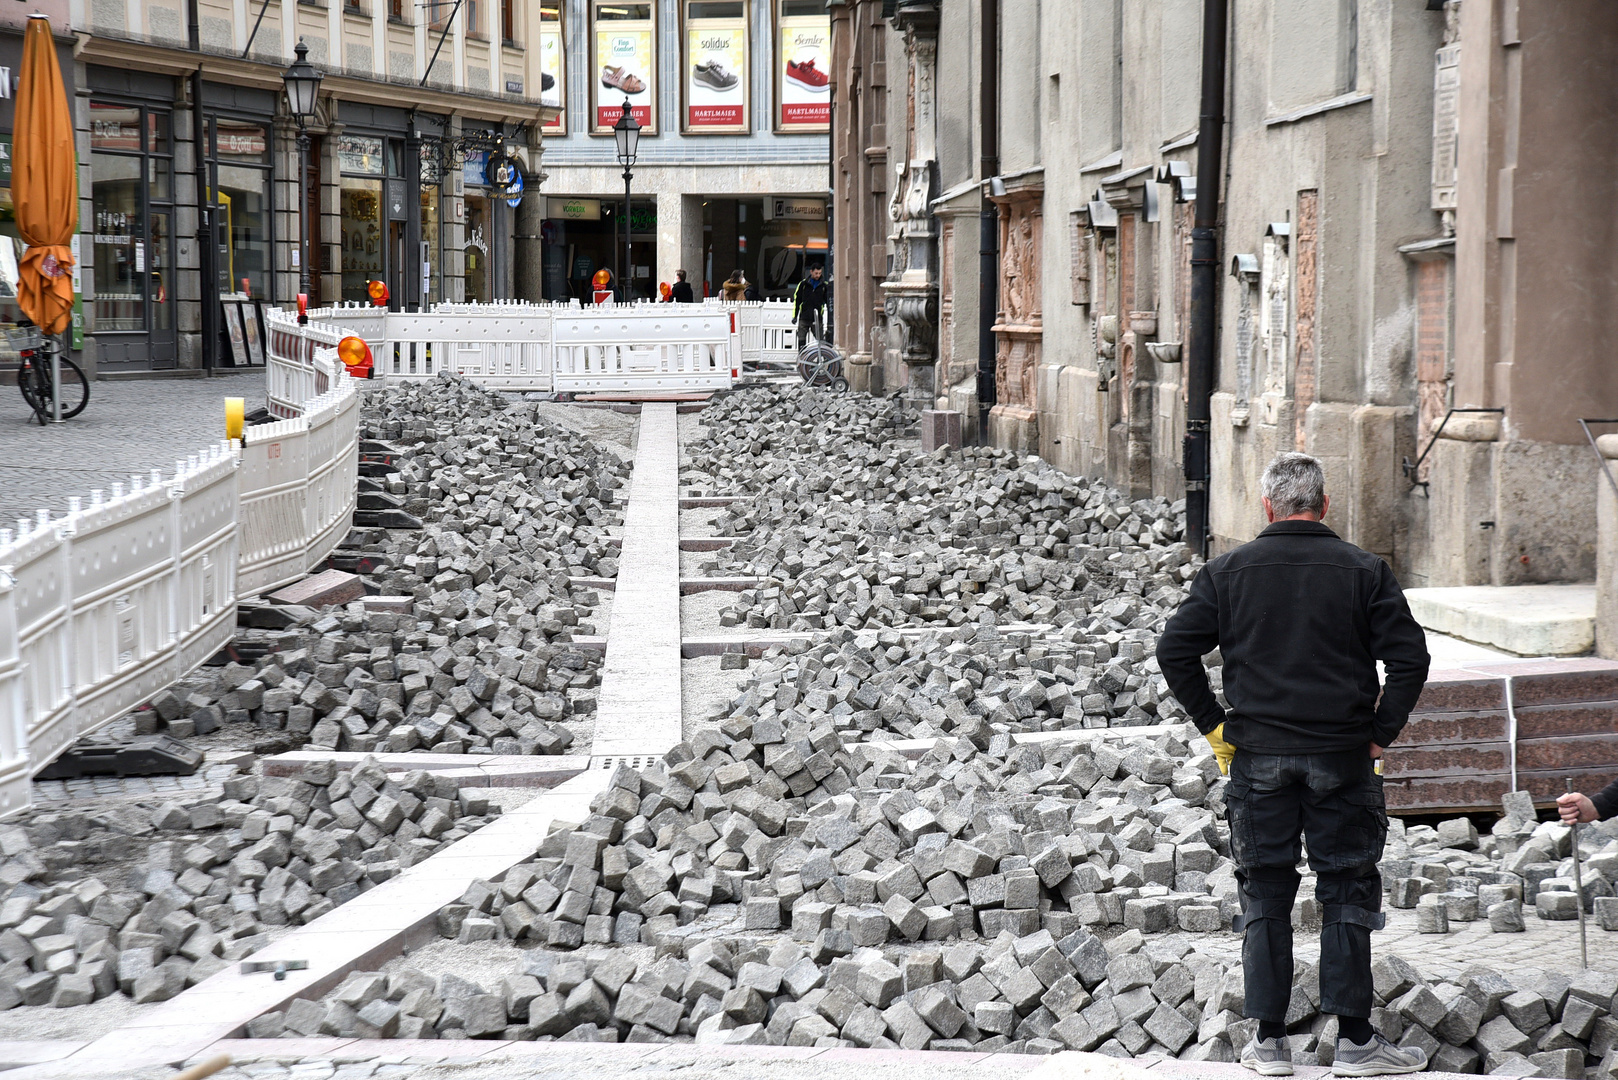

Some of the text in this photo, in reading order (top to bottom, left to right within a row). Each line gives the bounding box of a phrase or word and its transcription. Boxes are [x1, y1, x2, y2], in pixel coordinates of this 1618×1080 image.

[701, 36, 730, 49] solidus
[795, 33, 824, 45] Semler
[563, 205, 585, 213] VORWERK
